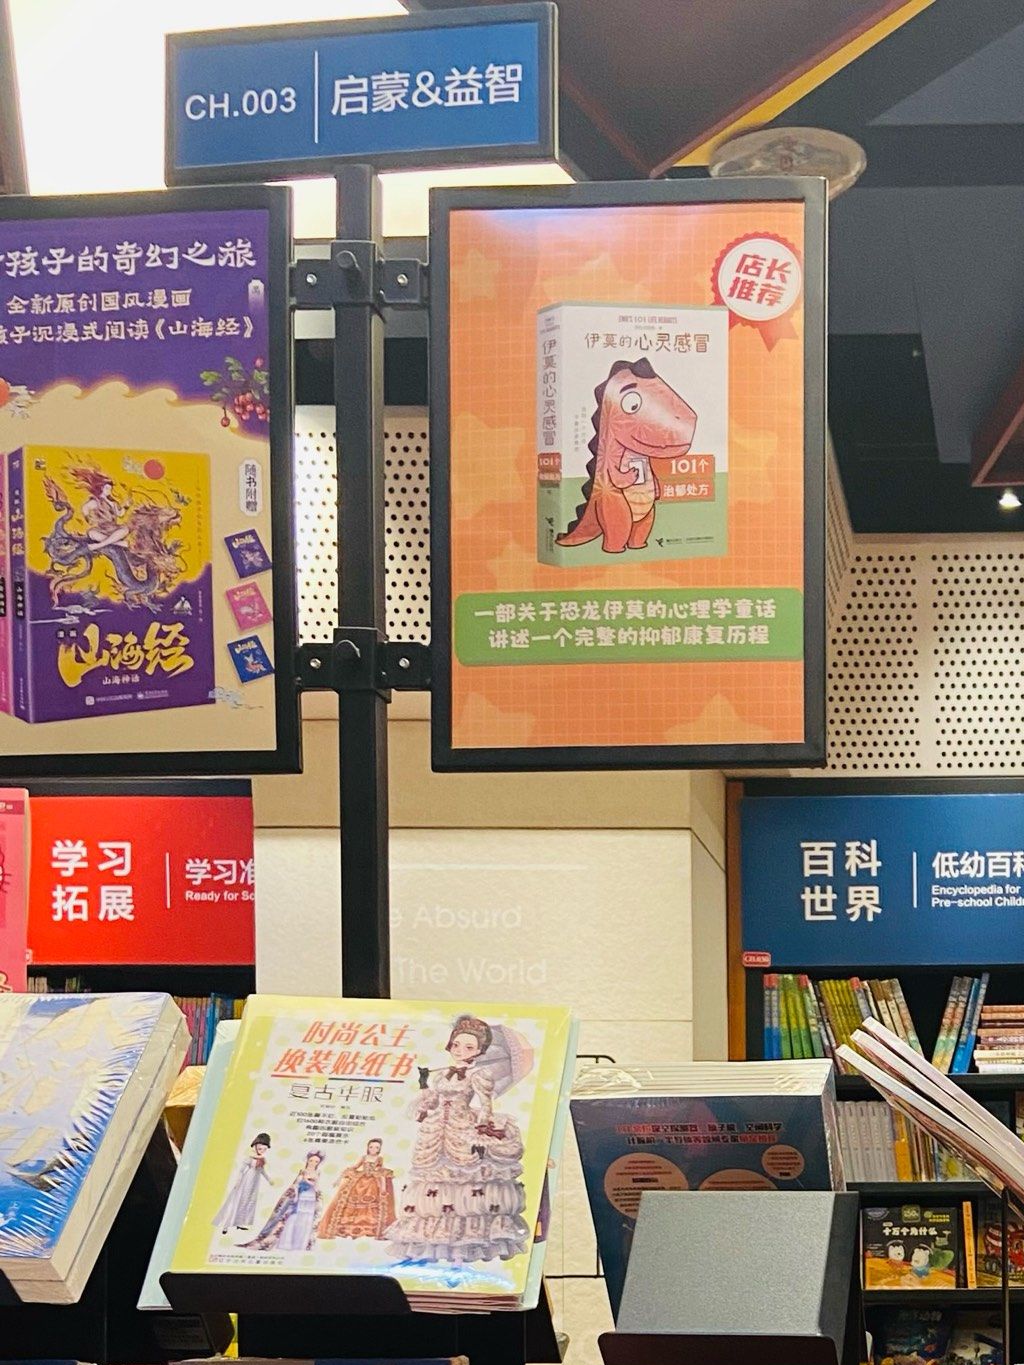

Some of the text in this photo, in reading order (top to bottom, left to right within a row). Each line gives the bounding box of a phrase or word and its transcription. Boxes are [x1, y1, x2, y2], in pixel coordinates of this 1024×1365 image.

[184, 86, 298, 122] CH.003
[330, 61, 524, 117] 启蒙&益智
[0, 238, 256, 278] 孩子的奇幻之旅
[734, 253, 793, 284] 店长
[7, 288, 192, 315] 全新原创国风漫画
[727, 276, 786, 307] 推荐
[584, 332, 710, 353] 伊莫的心灵感冒
[670, 457, 710, 476] 101个
[474, 598, 777, 624] 一部关于恐龙伊莫的心理学童话
[488, 624, 770, 650] 讲述一个完整的抑郁康复历程
[58, 620, 195, 688] 山海经
[50, 840, 131, 878] 学习
[800, 839, 882, 877] 百科
[51, 885, 135, 922] 拓展
[185, 890, 220, 903] Ready
[223, 889, 239, 901] for
[800, 885, 882, 922] 世界
[931, 884, 1021, 897] Encyclopedia for
[459, 955, 549, 986] World
[302, 1020, 416, 1048] 时尚公主
[273, 1048, 418, 1078] 换装贴纸书
[288, 1083, 385, 1103] 复古华服
[882, 1226, 938, 1237] 十万个为什么
